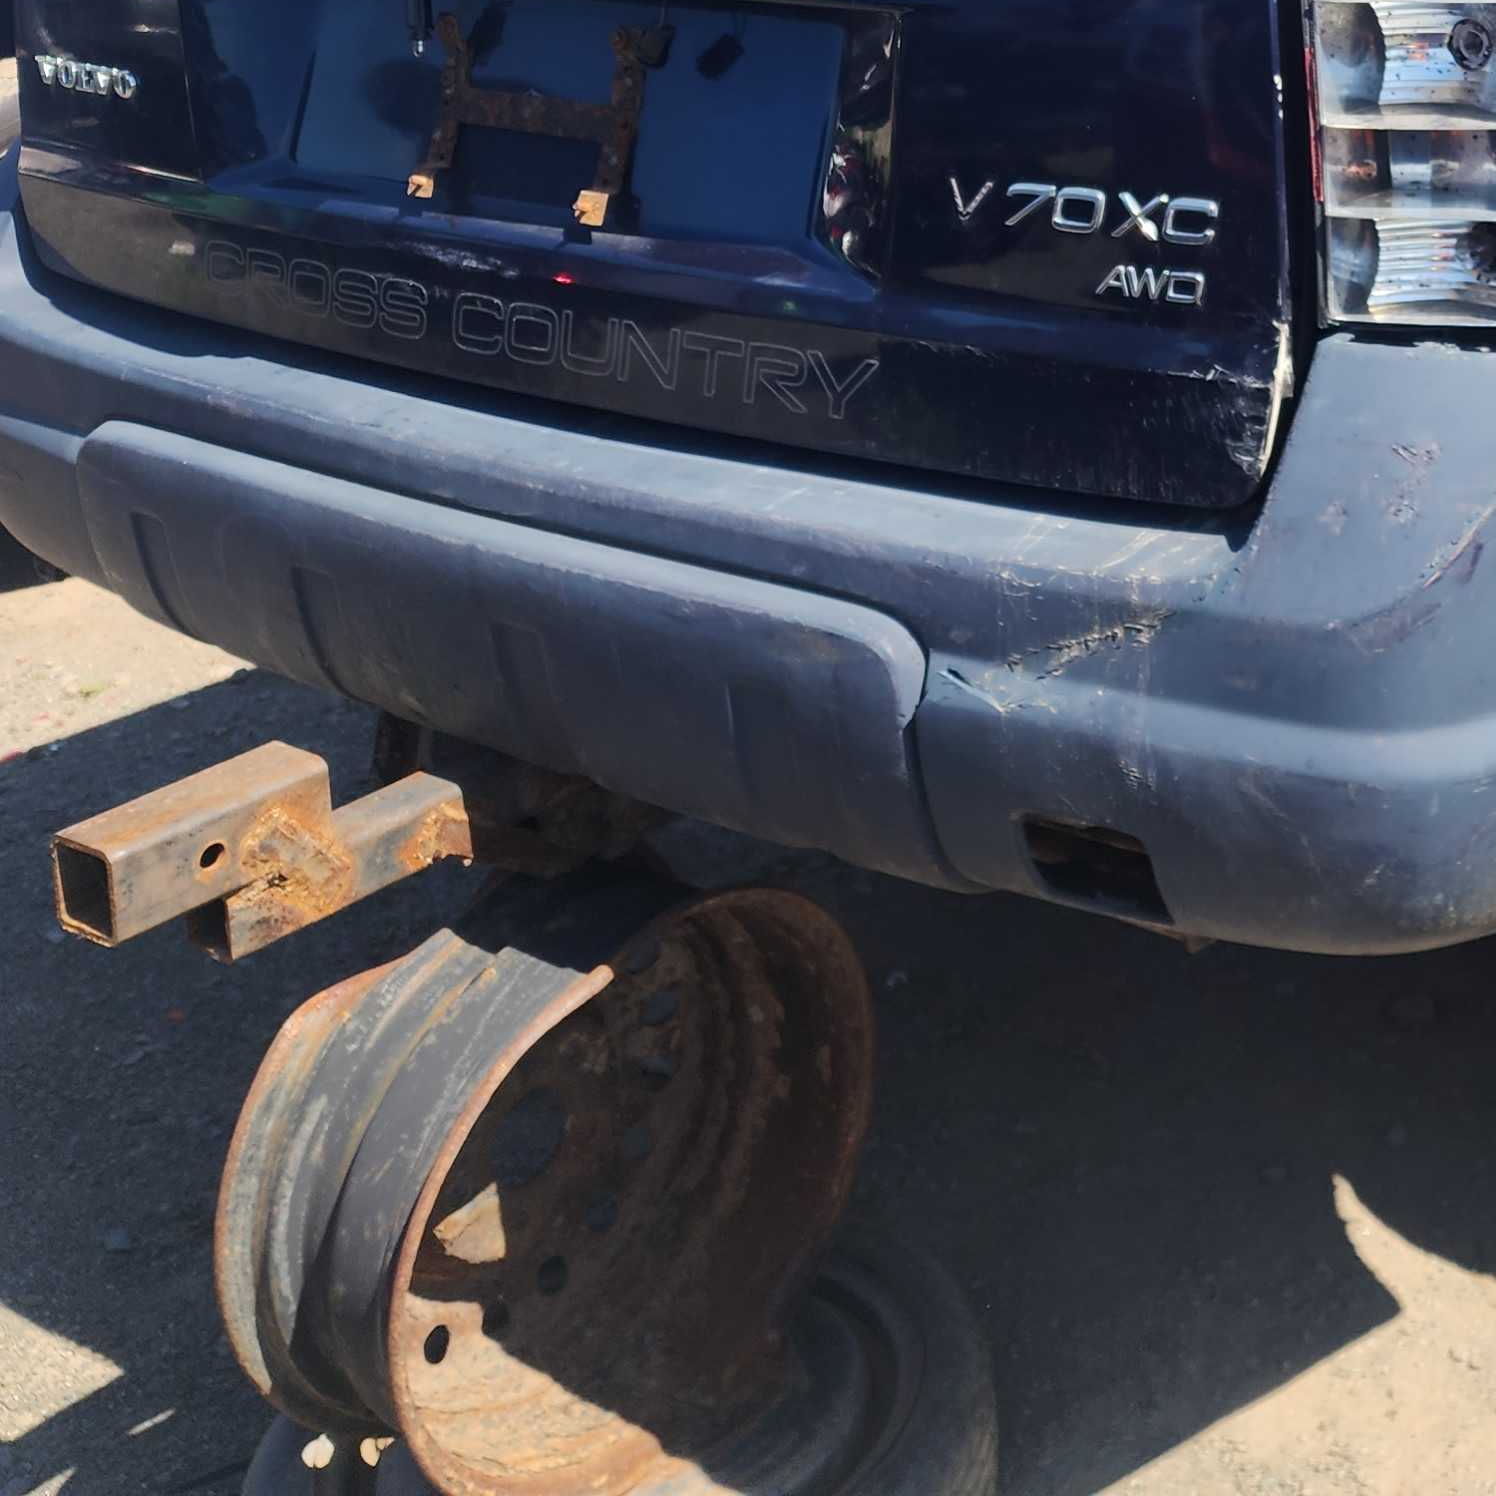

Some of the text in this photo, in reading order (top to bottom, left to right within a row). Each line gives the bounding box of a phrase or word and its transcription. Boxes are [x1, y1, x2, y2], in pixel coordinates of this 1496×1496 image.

[34, 55, 137, 99] VOLVO
[1095, 264, 1205, 305] AWD
[201, 240, 880, 420] CROSS COUNTRY
